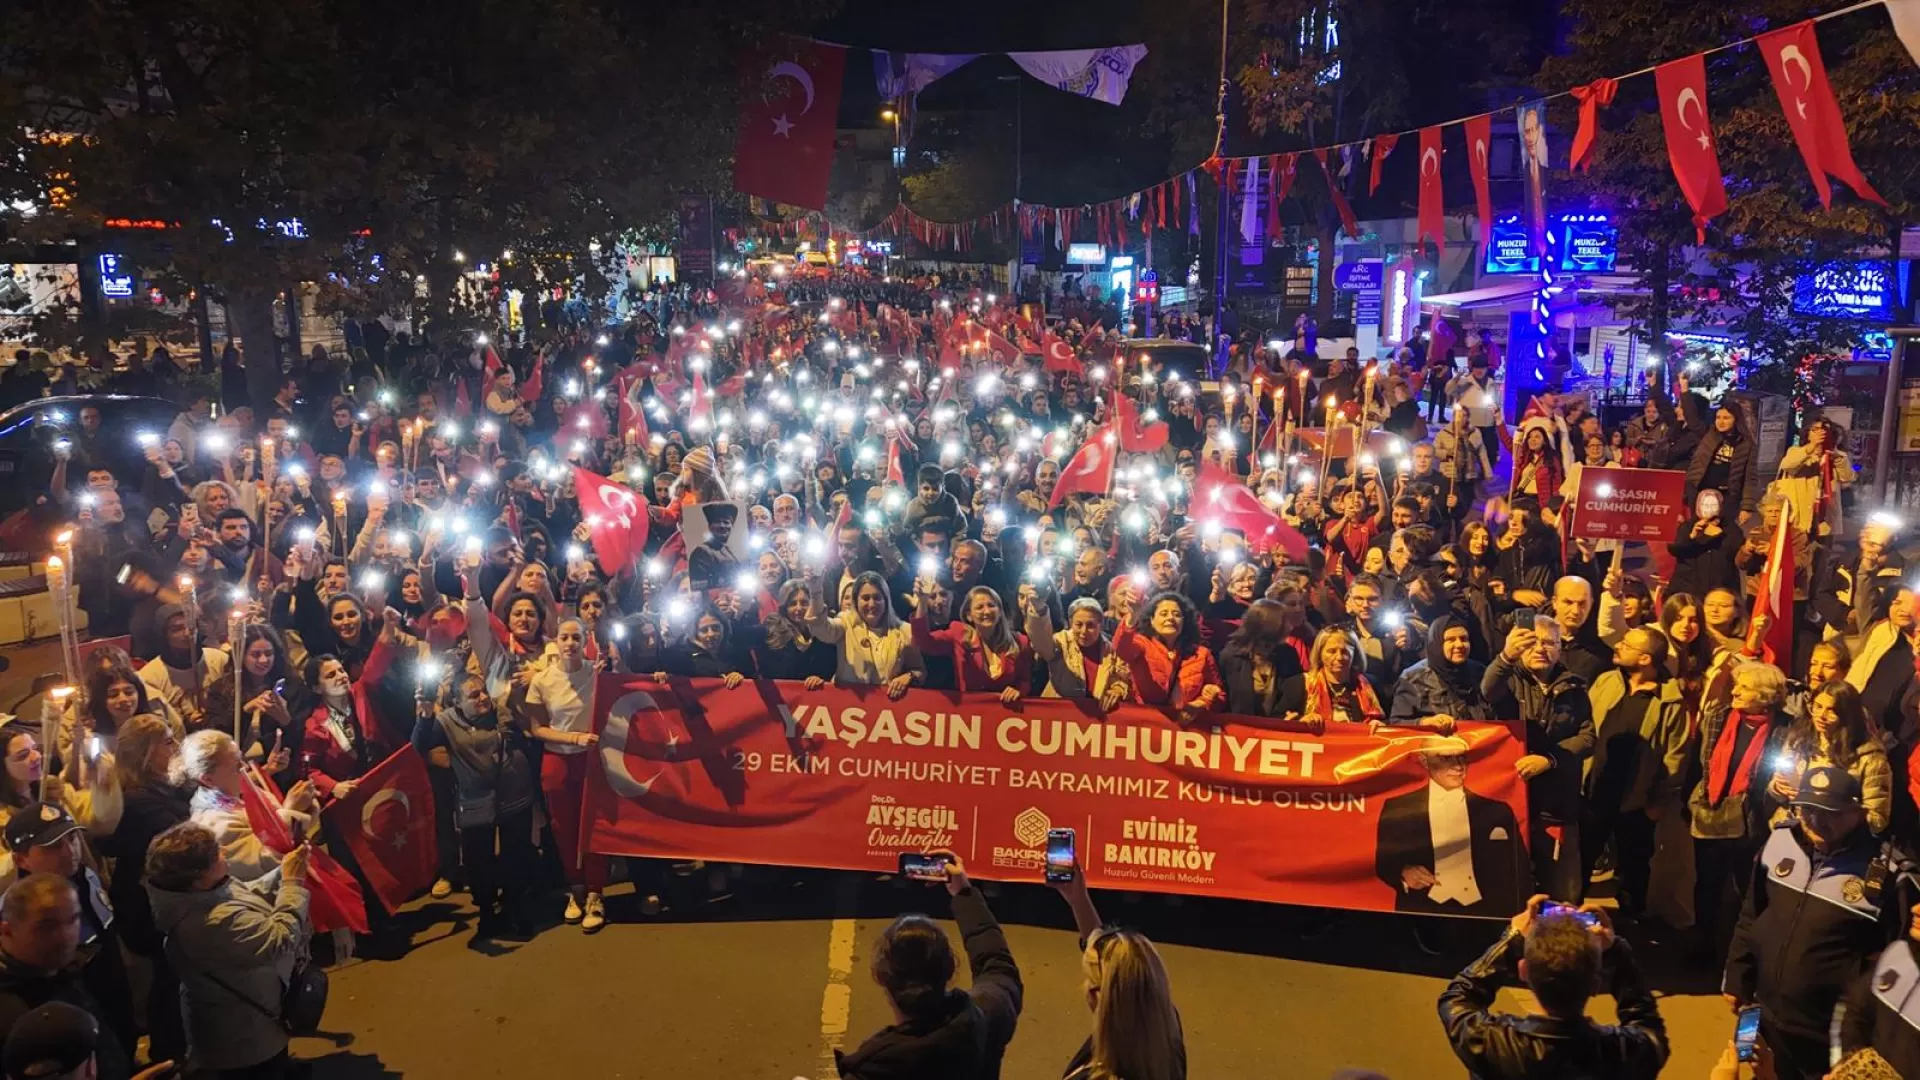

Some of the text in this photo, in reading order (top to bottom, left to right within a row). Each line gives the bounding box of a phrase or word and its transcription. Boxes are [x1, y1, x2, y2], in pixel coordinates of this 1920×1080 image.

[1500, 248, 1525, 256] TEKEL
[1578, 247, 1601, 255] TEKEL
[1585, 501, 1671, 515] CUMHURİYET
[777, 704, 1324, 777] YAŞASIN CUMHURİYET
[731, 751, 1367, 814] 29 EKİM CUMHURİYET BAYRAMIMIZ KUTLU OLSUN
[865, 804, 959, 831] AYŞEGÜL
[1122, 815, 1198, 844] EVİMİZ
[867, 828, 953, 853] Ovalıoğlu
[993, 847, 1047, 860] BAKIRK
[1104, 843, 1216, 871] BAKIRKÖY
[1103, 867, 1214, 884] Huzurlu Güvenli Modern
